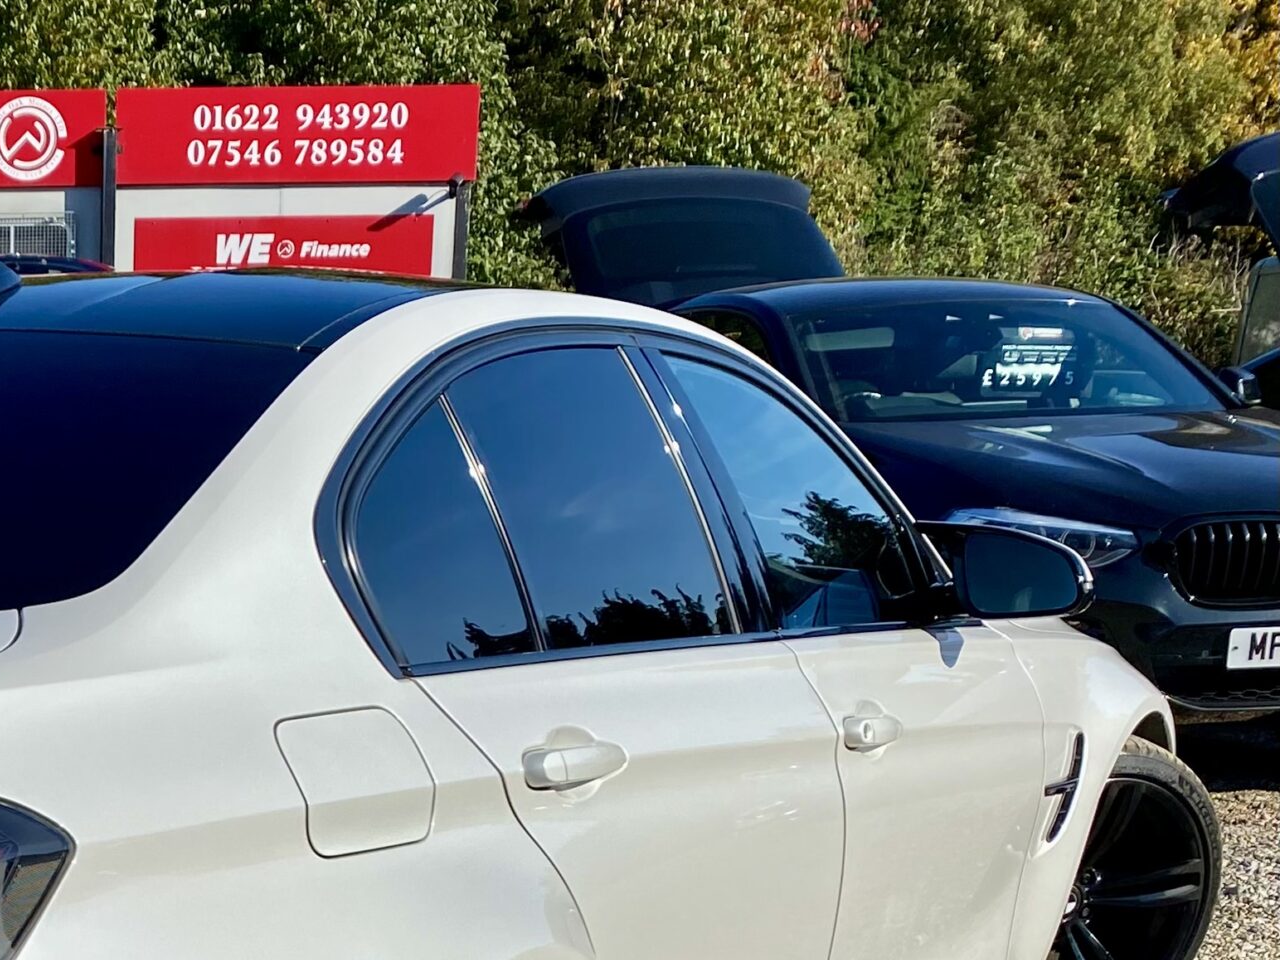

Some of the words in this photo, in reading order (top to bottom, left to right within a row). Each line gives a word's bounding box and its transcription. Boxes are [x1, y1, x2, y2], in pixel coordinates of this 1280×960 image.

[193, 104, 279, 131] 01622
[295, 102, 409, 131] 943920
[187, 139, 282, 166] 07546
[294, 138, 404, 165] 789584
[215, 233, 275, 264] WE
[300, 240, 371, 258] Finance
